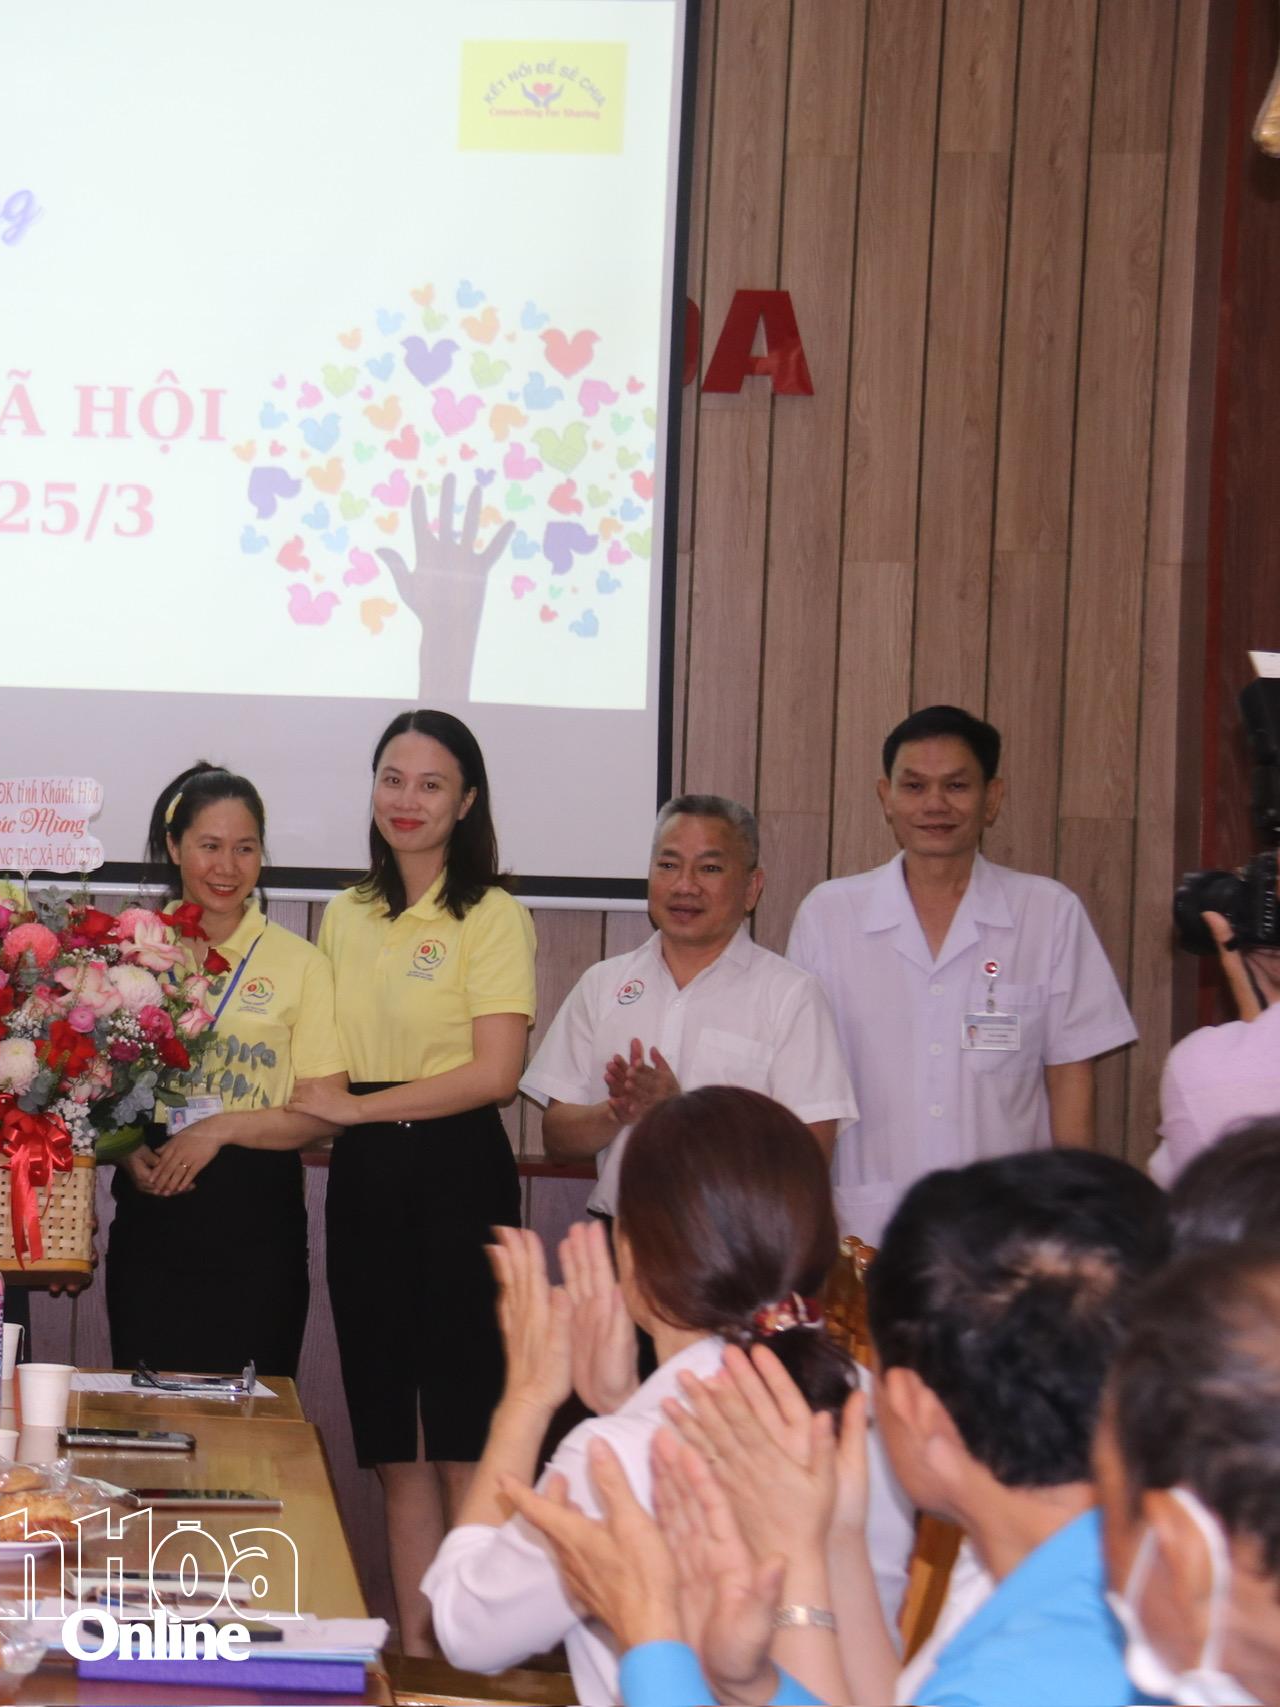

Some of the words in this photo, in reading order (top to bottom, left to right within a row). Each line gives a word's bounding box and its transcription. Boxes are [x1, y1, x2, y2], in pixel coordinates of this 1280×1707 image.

[683, 290, 815, 396] A
[73, 370, 228, 455] HỘI
[40, 779, 74, 804] Khánh
[19, 807, 86, 839] Mừng
[17, 841, 38, 866] TÁC
[39, 843, 55, 866] XÃ
[56, 843, 76, 868] HỘI
